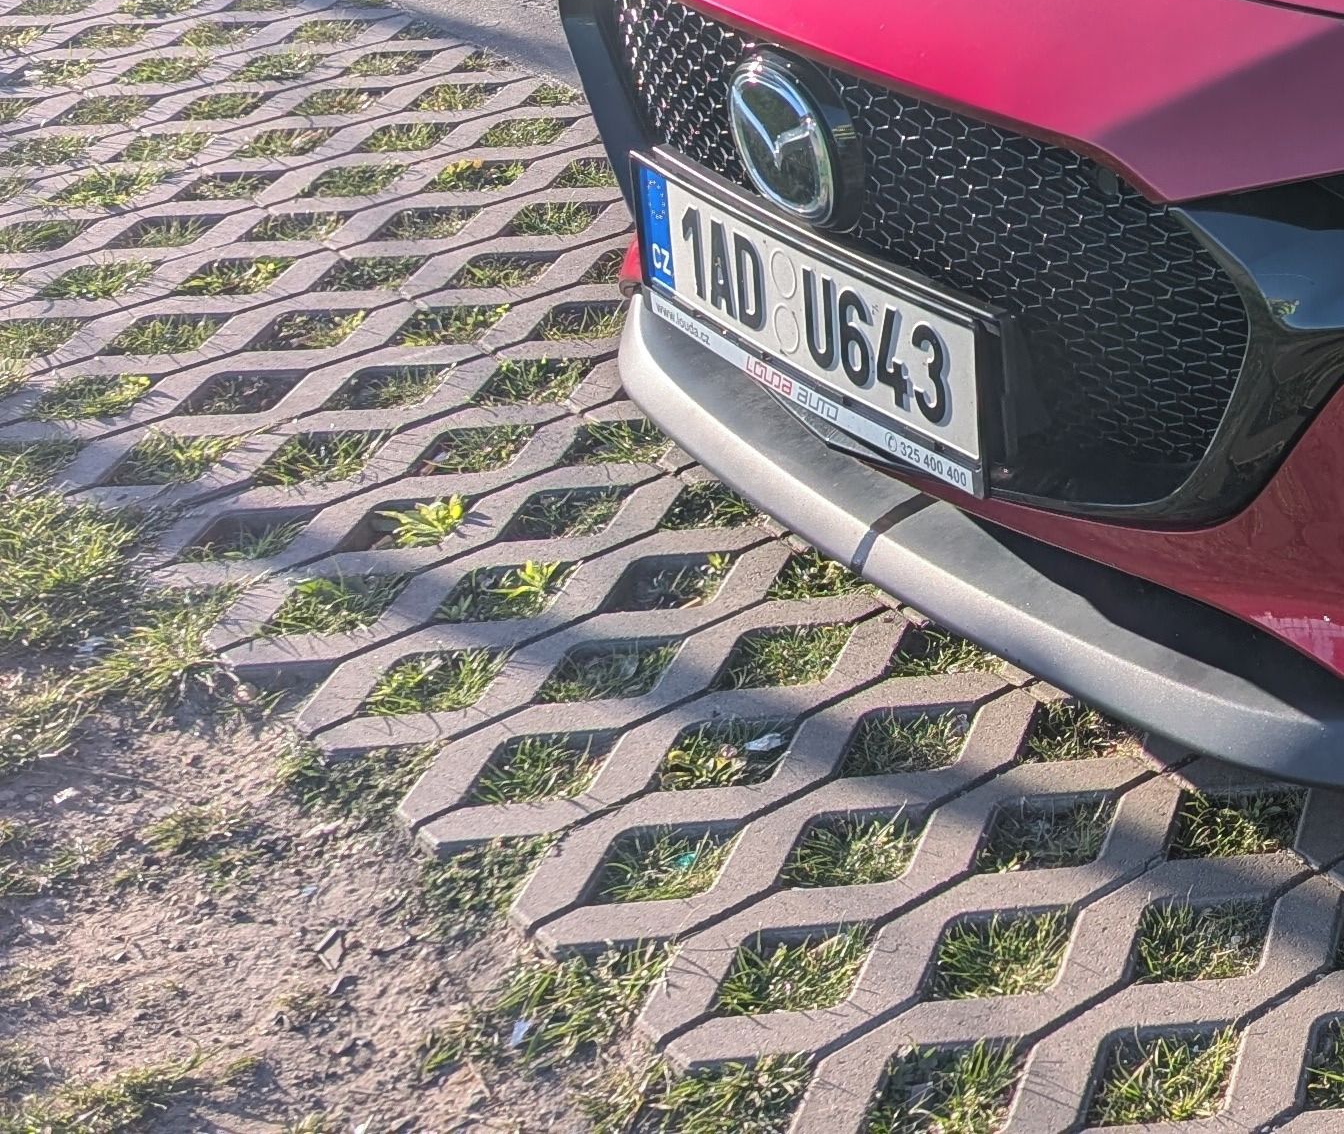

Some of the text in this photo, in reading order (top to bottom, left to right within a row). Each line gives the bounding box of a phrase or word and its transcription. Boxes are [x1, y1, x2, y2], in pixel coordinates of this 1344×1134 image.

[652, 242, 672, 276] CZ
[655, 300, 711, 346] www.louda.cz
[682, 204, 950, 425] 1AD U643
[899, 441, 967, 487] 325 400 400
